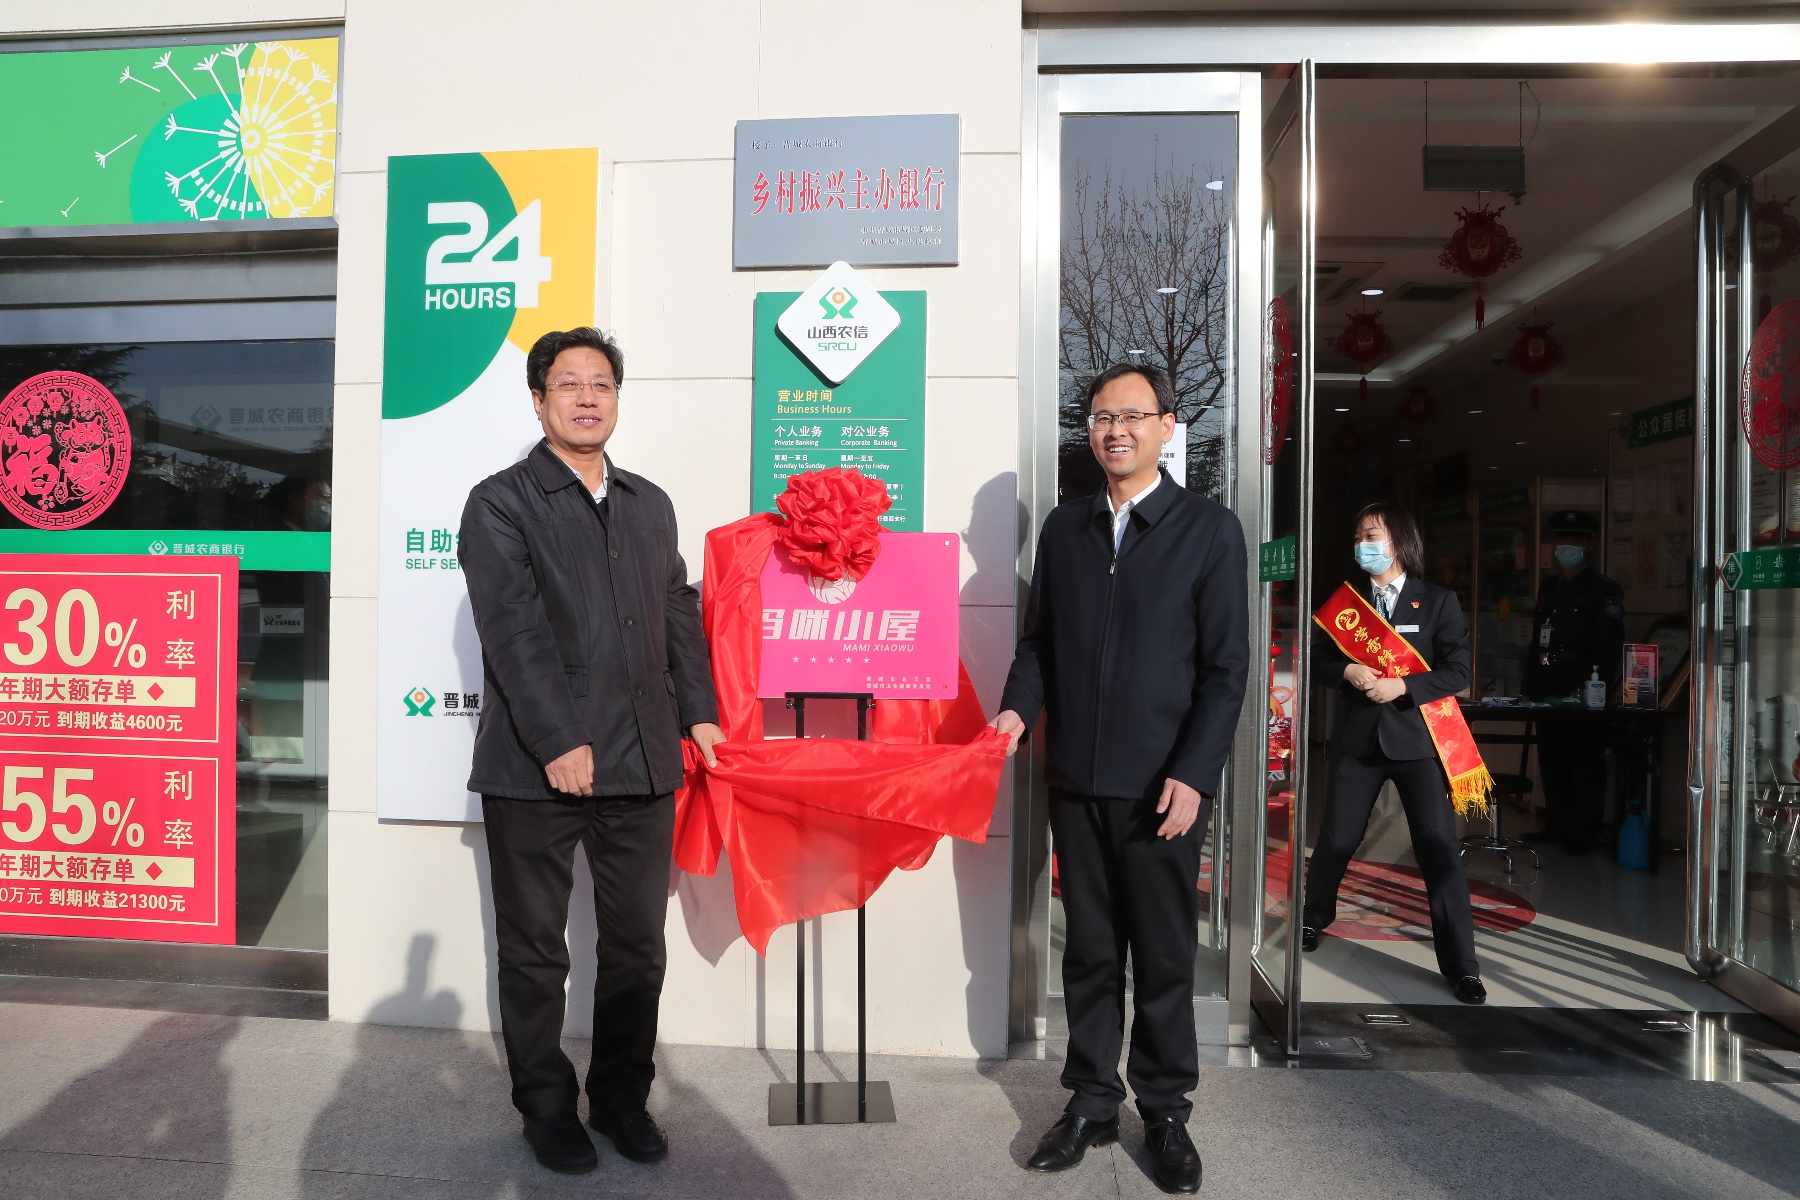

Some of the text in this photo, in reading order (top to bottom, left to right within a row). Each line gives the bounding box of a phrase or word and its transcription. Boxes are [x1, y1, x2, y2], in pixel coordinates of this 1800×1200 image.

[751, 166, 946, 216] 乡村振兴主办银行
[425, 198, 552, 308] 24
[425, 287, 511, 310] HOURS
[807, 326, 869, 339] 山西农信
[818, 342, 857, 351] SRCU
[778, 390, 832, 403] 营业时间
[777, 405, 852, 414] Business Hours
[774, 425, 823, 437] 个人业务
[841, 425, 890, 437] 对公业务
[841, 440, 871, 448] Corporate
[172, 543, 245, 556] 晋城农商银行
[406, 528, 459, 553] 自助
[405, 558, 437, 570] SELF
[4, 587, 147, 669] 30%
[165, 590, 196, 669] 利率
[843, 644, 914, 652] MAMI XIAOWU
[0, 677, 137, 703] 年期大额存单
[443, 692, 479, 709] 晋城
[0, 710, 183, 732] 20万元 到期收益4600元
[2, 766, 145, 848] 55%
[164, 770, 194, 850] 利率
[0, 853, 135, 882] 年期大额存单
[49, 889, 186, 912] 到期收益21300元
